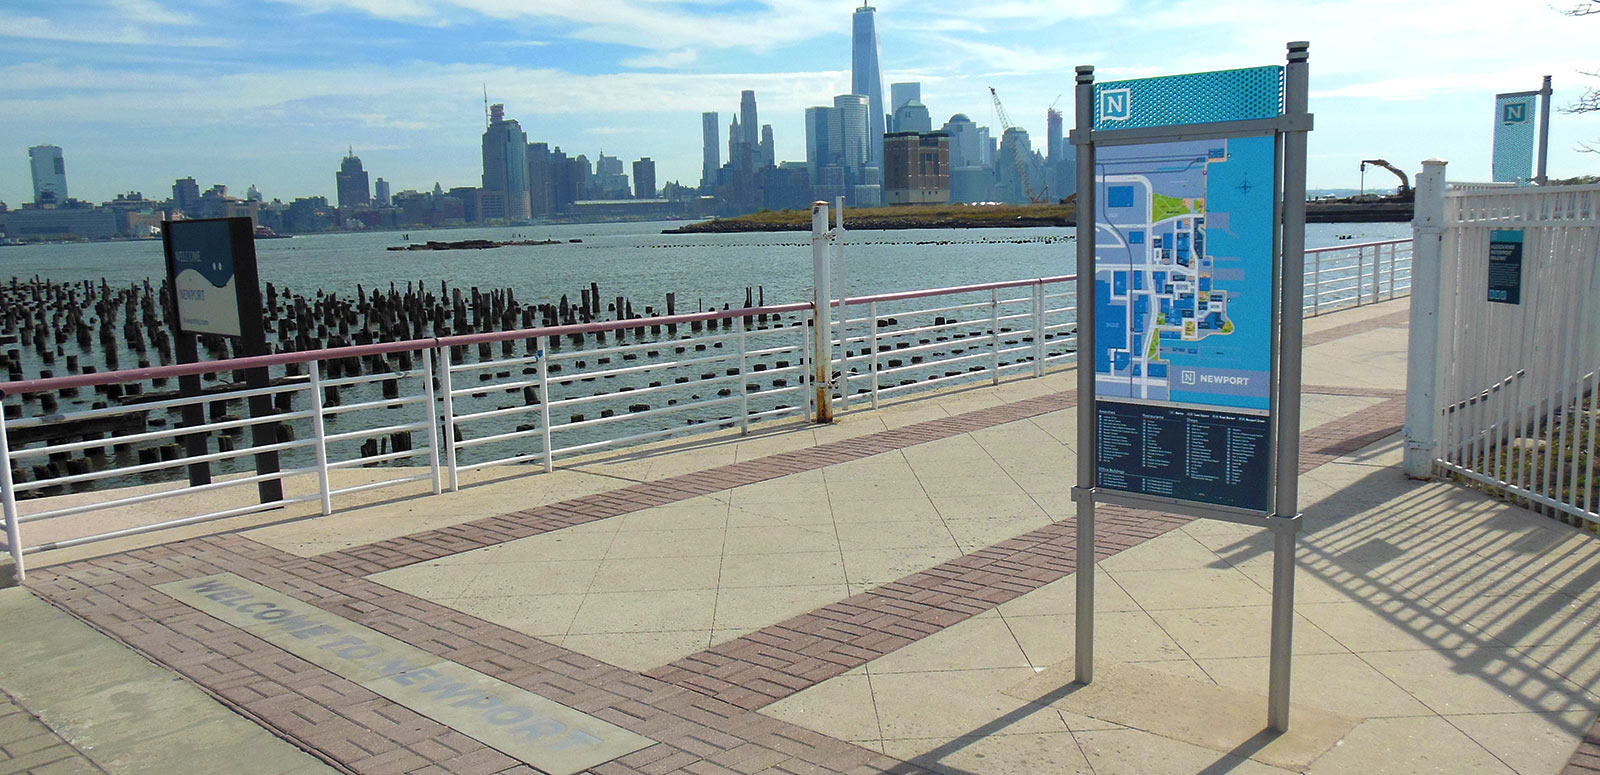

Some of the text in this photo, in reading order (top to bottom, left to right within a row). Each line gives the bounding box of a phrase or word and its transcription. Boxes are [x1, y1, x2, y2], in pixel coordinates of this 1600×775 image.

[1200, 374, 1249, 385] NEWPORT
[188, 577, 605, 752] WELCOME TO NEWPORT
